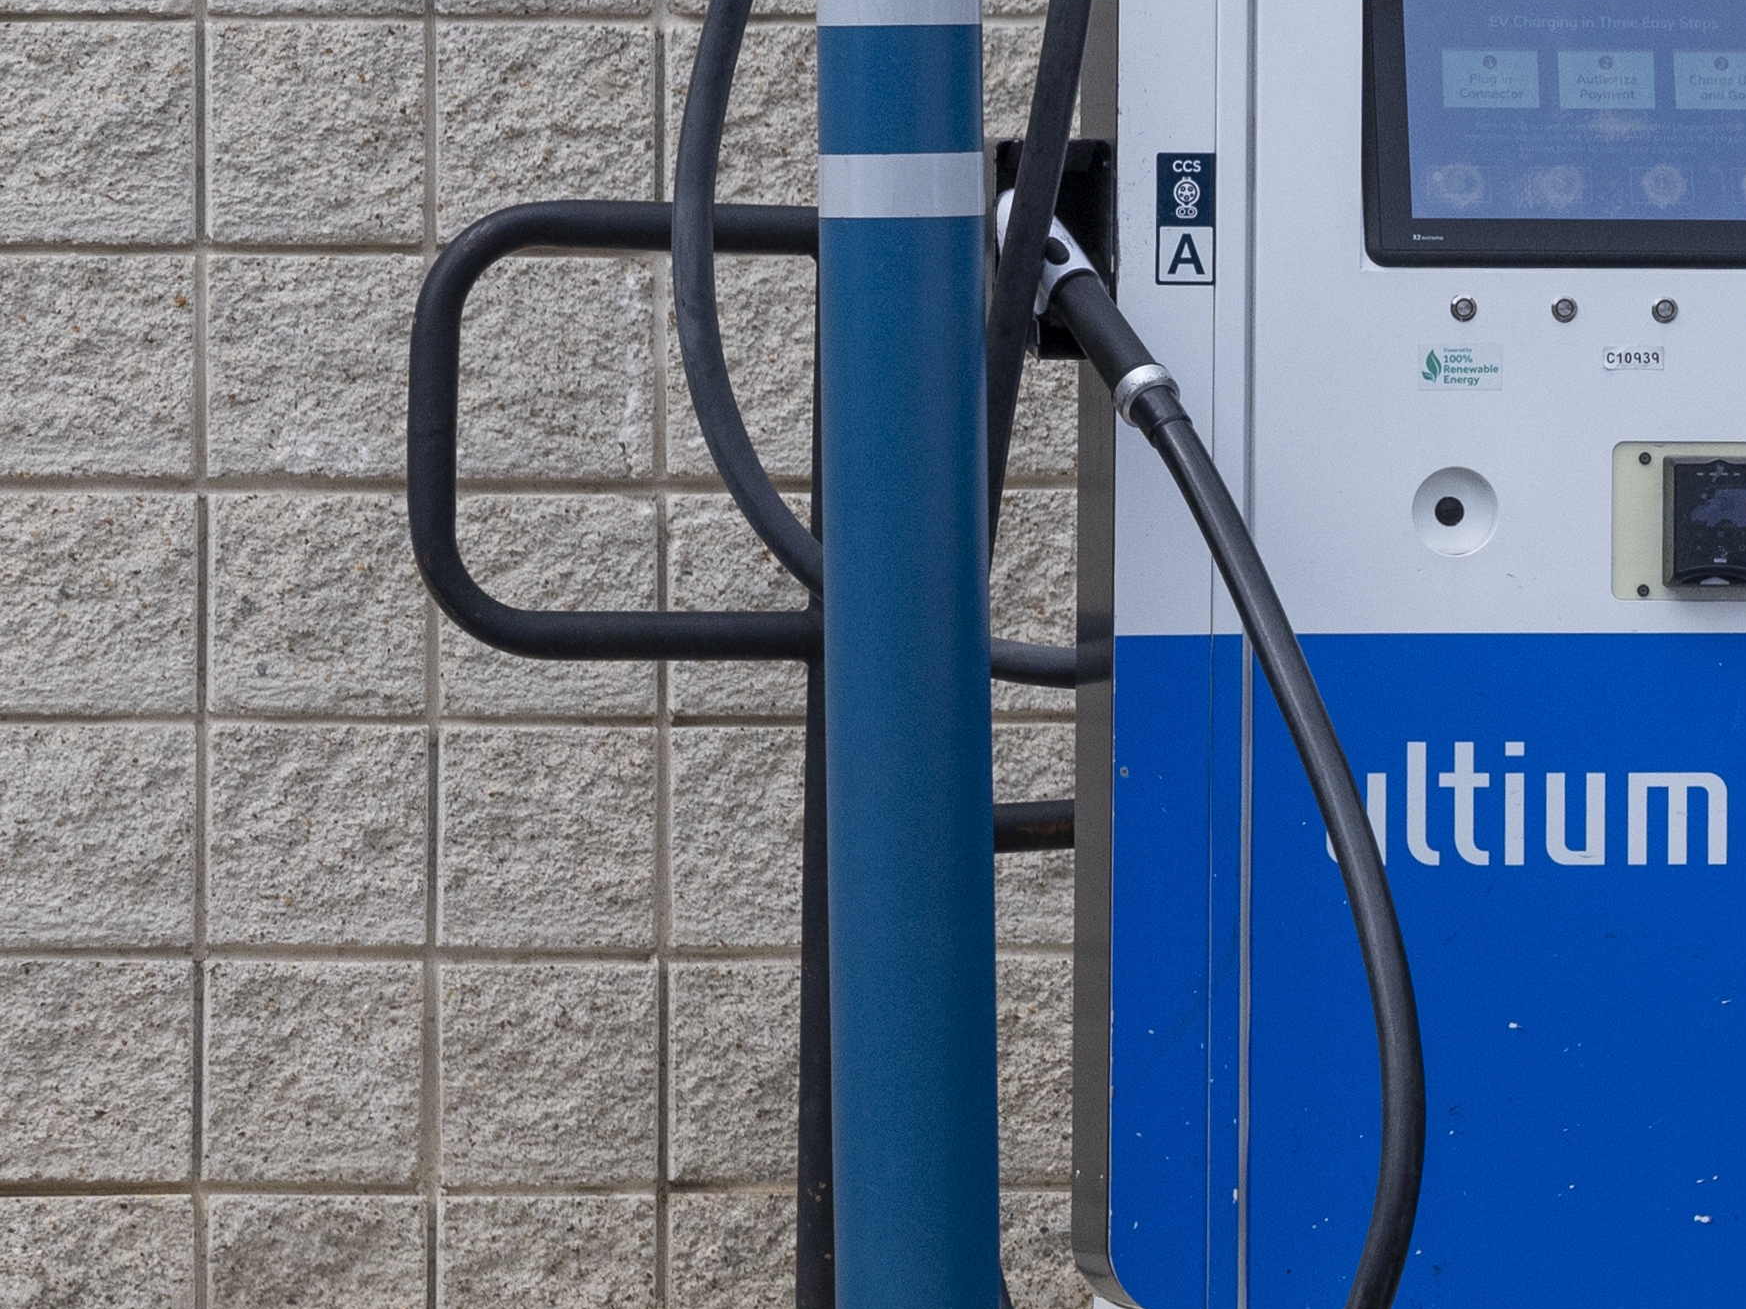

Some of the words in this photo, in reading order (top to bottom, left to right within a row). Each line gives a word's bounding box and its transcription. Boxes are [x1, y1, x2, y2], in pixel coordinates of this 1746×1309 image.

[1490, 16, 1509, 29] EV
[1513, 15, 1579, 32] Charging
[1582, 16, 1595, 29] in
[1599, 16, 1640, 29] Three
[1642, 16, 1676, 32] Easy
[1468, 74, 1498, 87] Plug
[1576, 74, 1638, 86] Authorize
[1459, 89, 1524, 100] Connector
[1579, 90, 1636, 102] Payment
[1700, 90, 1724, 101] and
[1728, 90, 1746, 101] Go
[1172, 159, 1202, 173] CCS
[1167, 233, 1206, 275] A
[1443, 354, 1473, 364] 100%
[1606, 351, 1660, 365] C10939
[1443, 364, 1499, 374] Renewable
[1443, 374, 1480, 386] Energy
